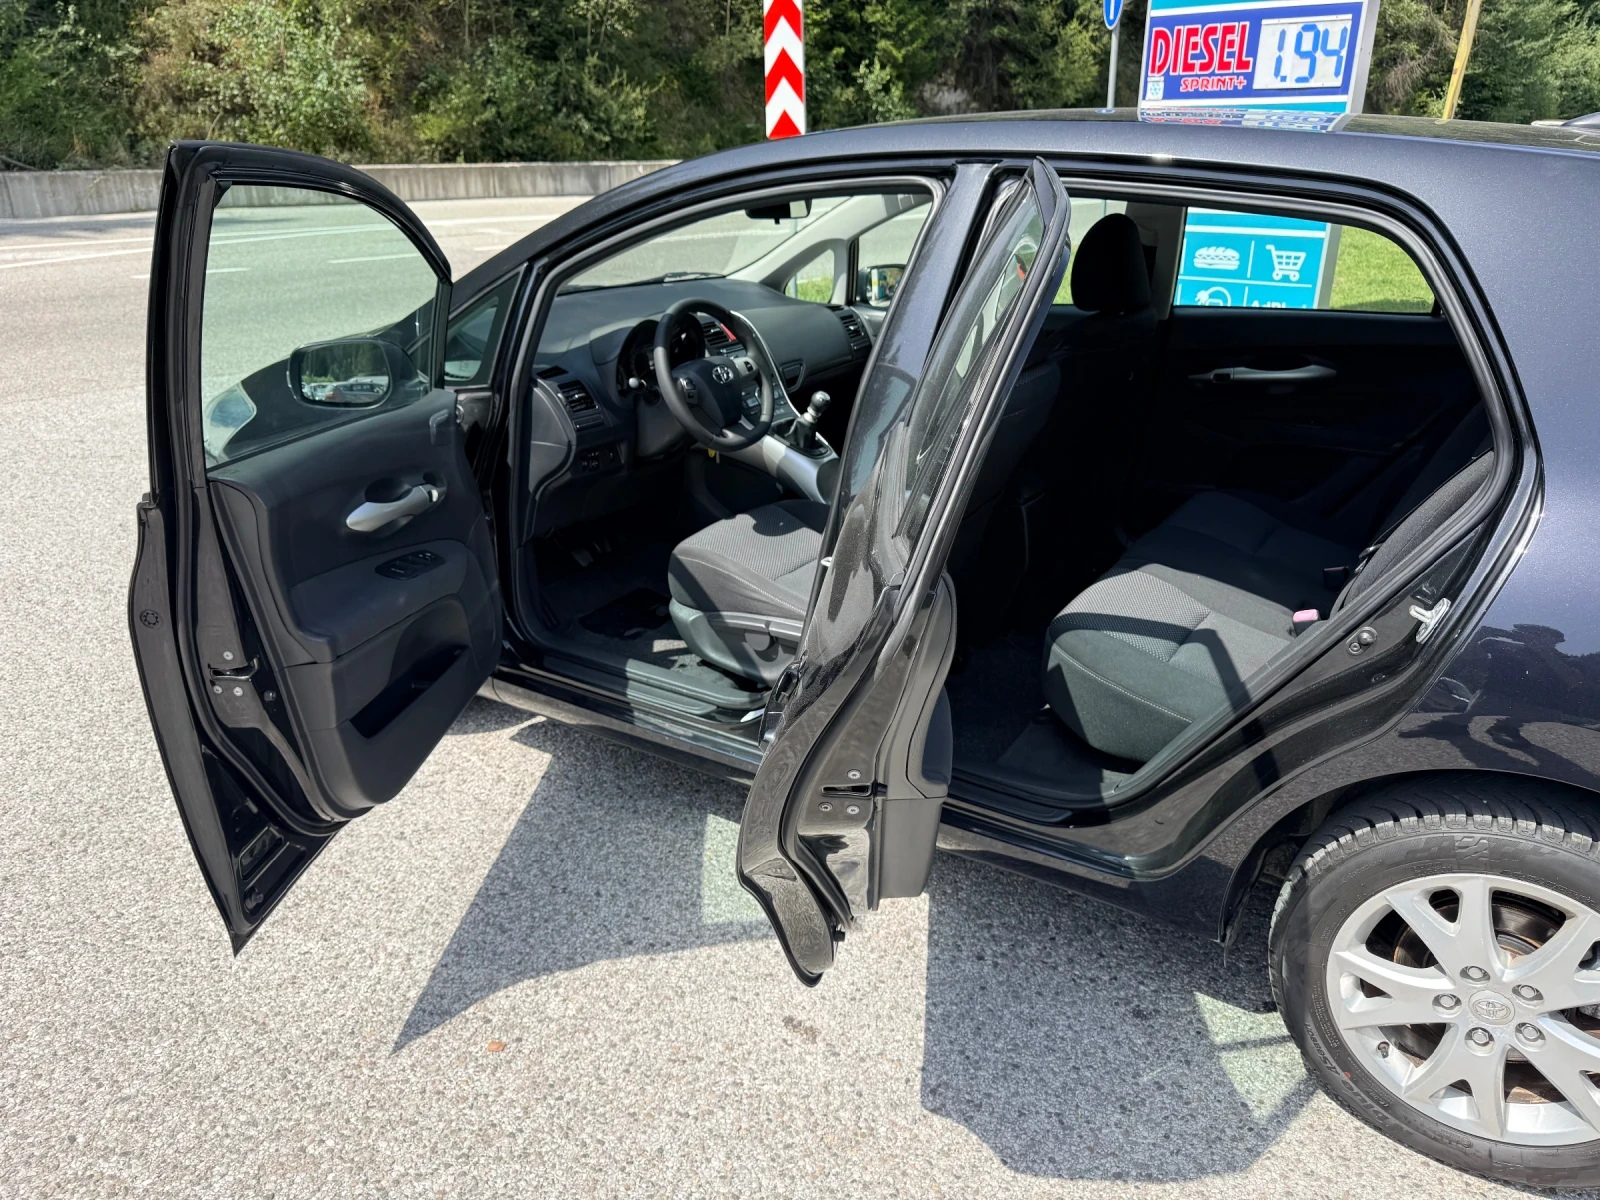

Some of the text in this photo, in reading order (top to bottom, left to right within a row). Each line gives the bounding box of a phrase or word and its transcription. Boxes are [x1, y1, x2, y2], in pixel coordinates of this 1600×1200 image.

[1149, 21, 1253, 76] DIESEL
[1273, 23, 1349, 83] 1.94
[1180, 76, 1247, 92] SPRINT+
